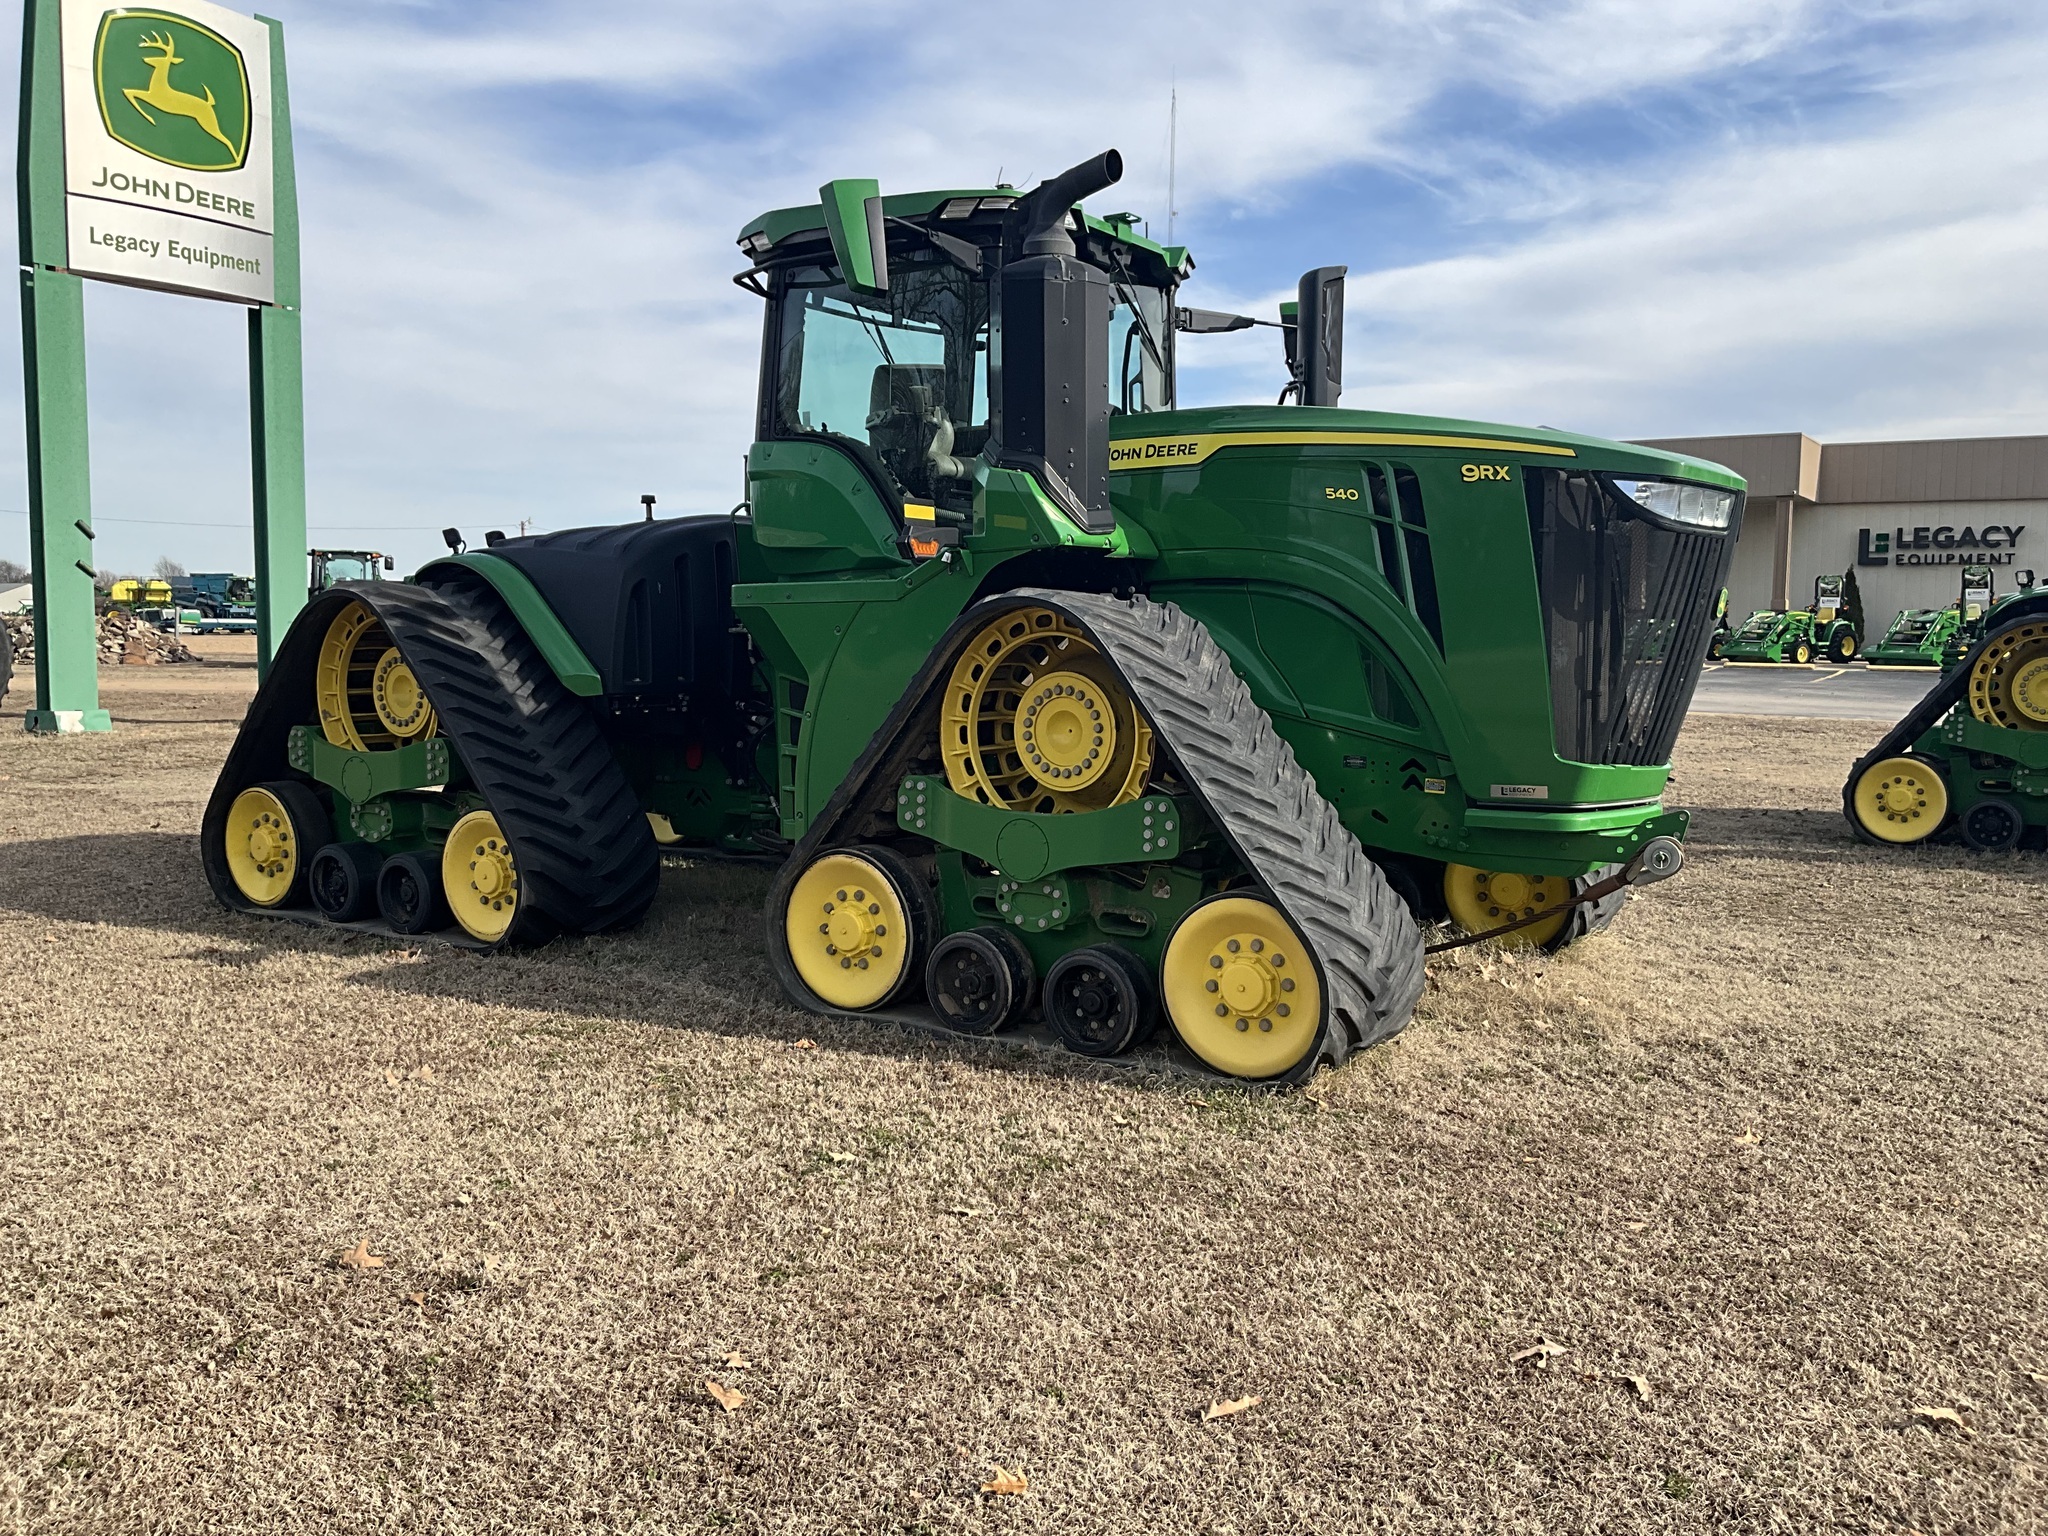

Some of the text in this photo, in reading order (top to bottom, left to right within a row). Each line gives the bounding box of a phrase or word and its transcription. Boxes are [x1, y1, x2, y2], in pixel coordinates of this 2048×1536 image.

[92, 166, 256, 220] JOHN DEERE
[89, 226, 261, 275] Legacy Equipment
[1109, 443, 1198, 461] OHN DEERE
[1460, 463, 1512, 482] 9RX
[1325, 487, 1359, 501] 540
[1896, 525, 2026, 549] LEGACY
[1896, 553, 2016, 565] EQUIPMENT
